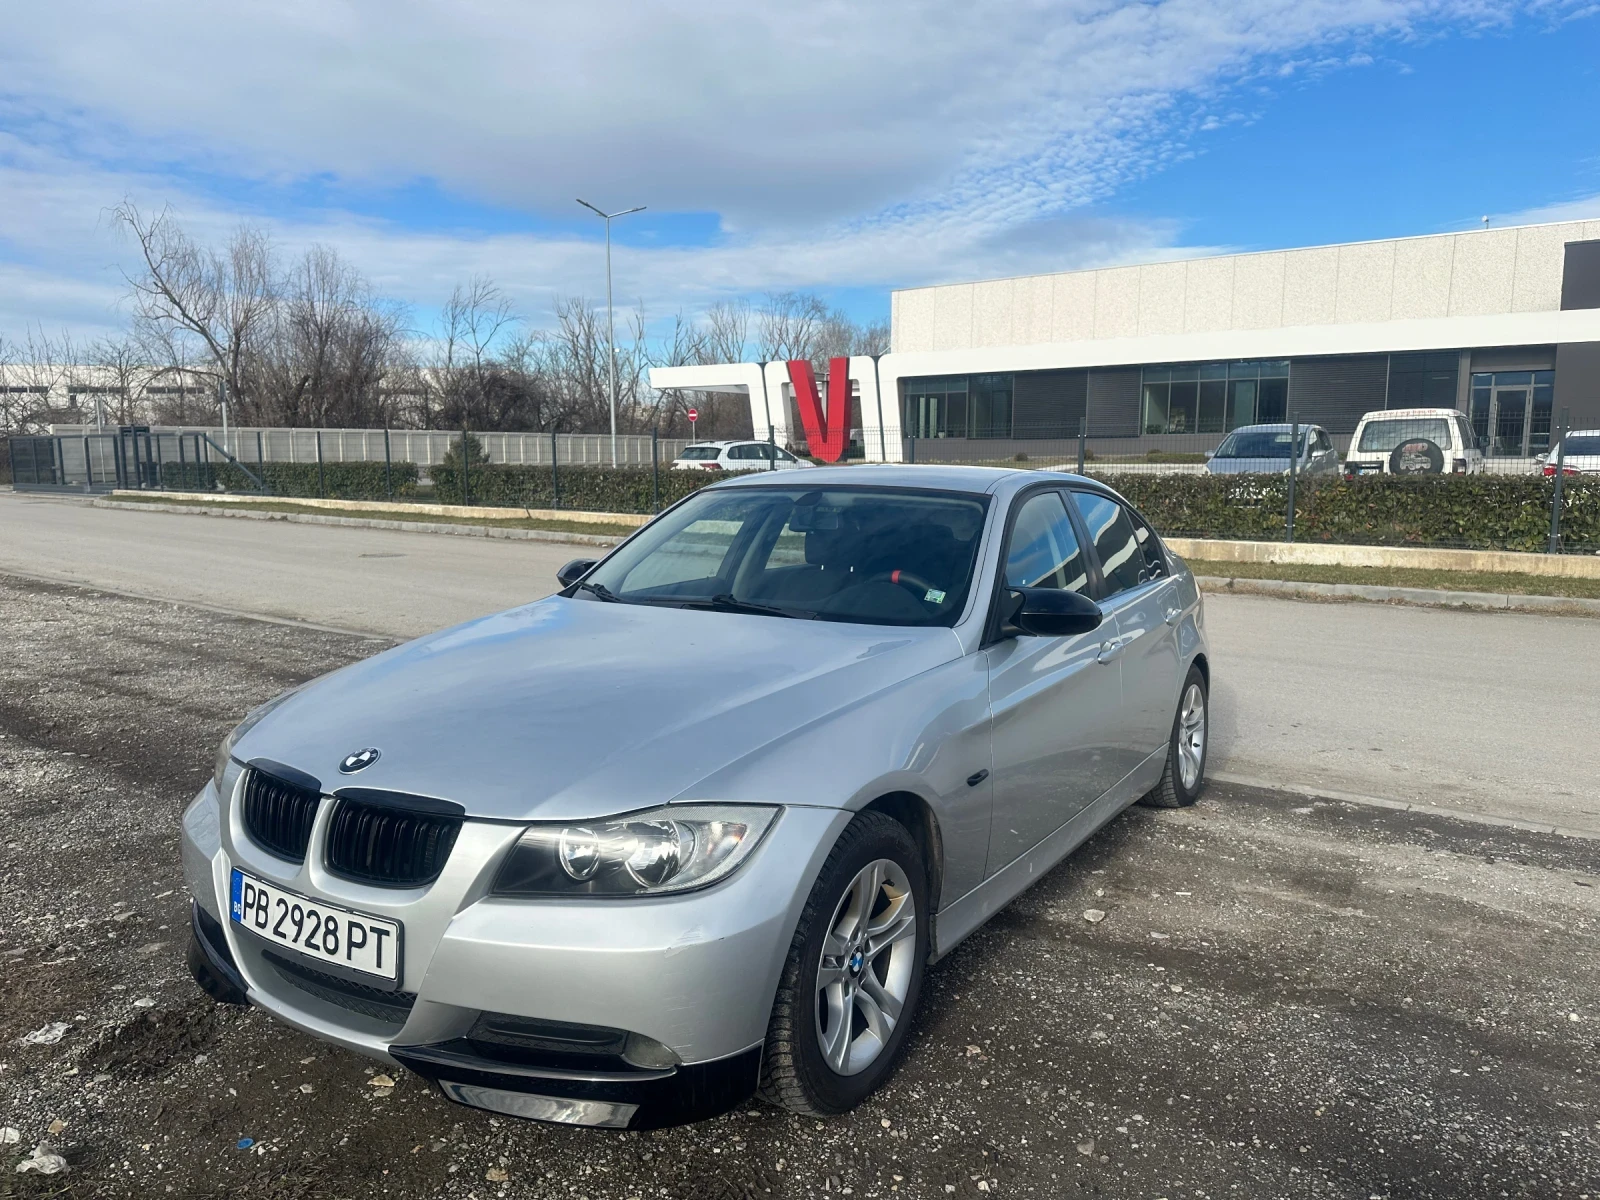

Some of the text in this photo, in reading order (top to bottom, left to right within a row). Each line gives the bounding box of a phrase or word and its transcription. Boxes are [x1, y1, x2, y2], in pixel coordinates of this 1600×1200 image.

[243, 882, 391, 969] PB 2928 PT
